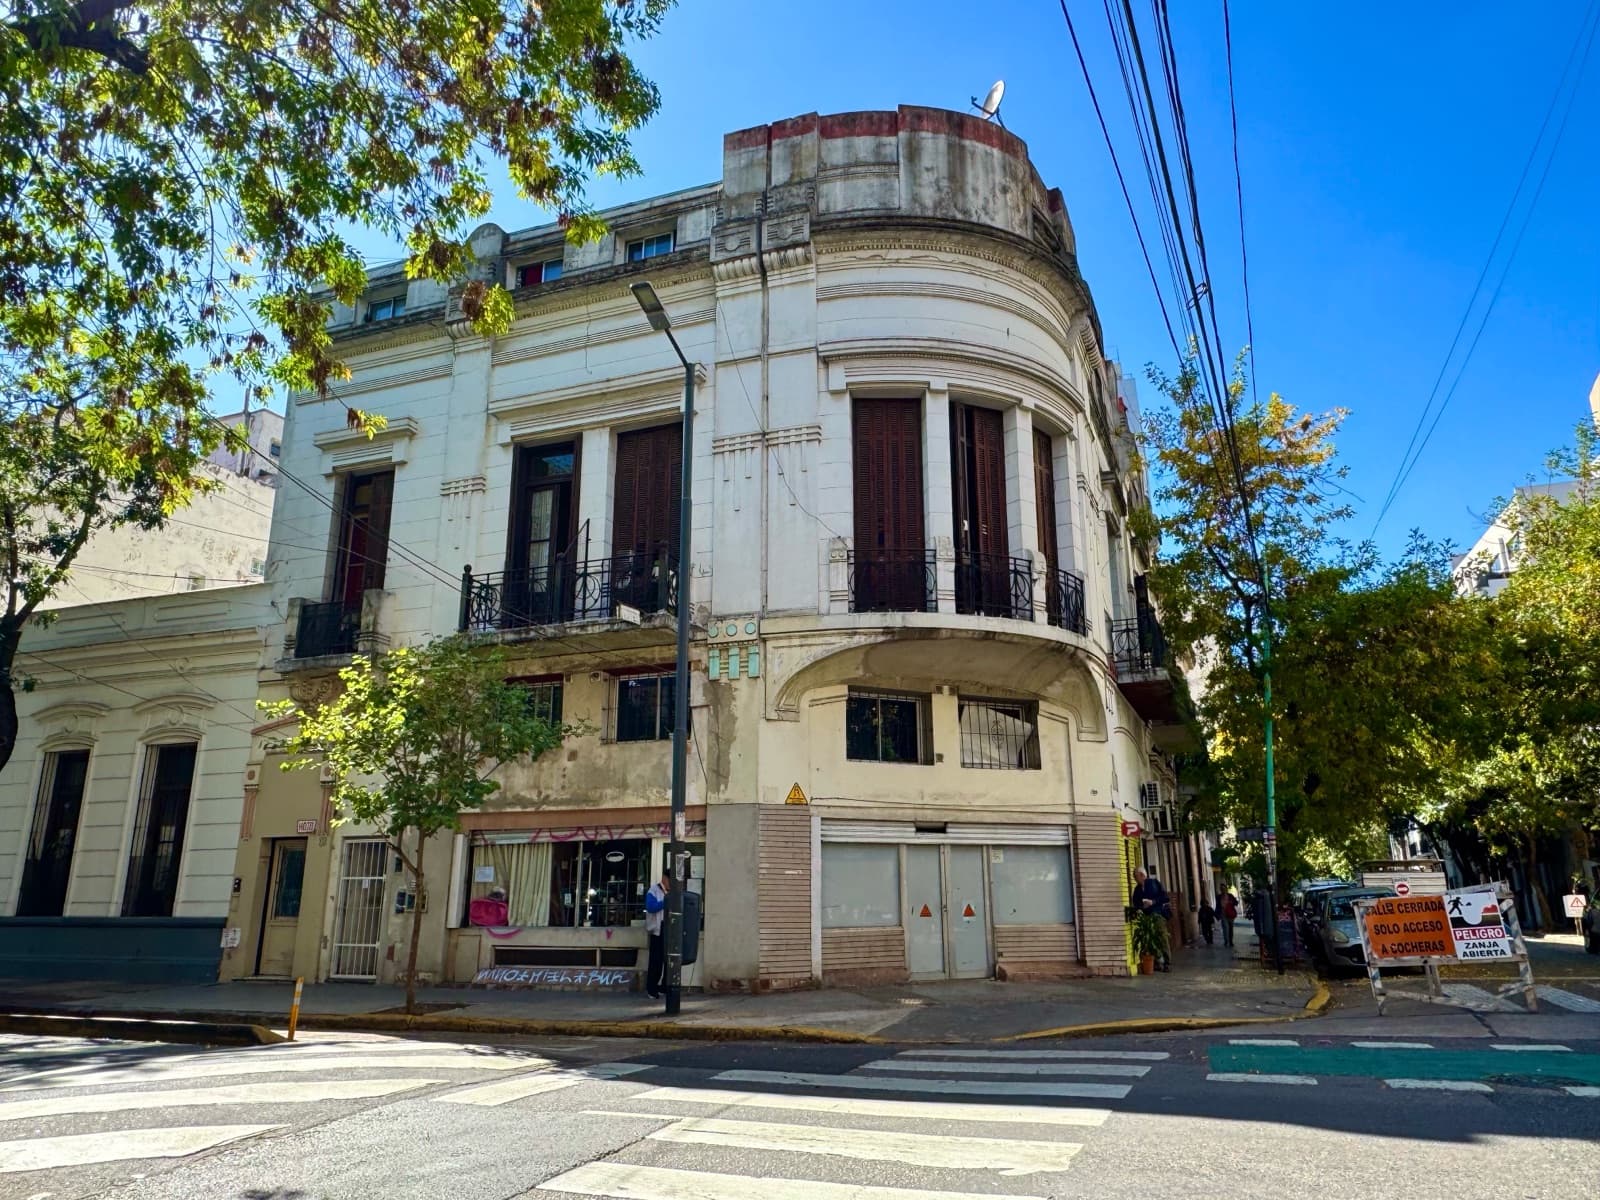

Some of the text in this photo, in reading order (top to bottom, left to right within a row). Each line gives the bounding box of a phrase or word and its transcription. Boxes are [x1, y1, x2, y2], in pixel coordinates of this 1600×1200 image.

[1397, 900, 1446, 914] CERRADA
[1374, 920, 1443, 936] SOLO ACCESO
[1455, 928, 1503, 940] PELIGRO
[1381, 940, 1446, 955] A COCHERAS
[1464, 941, 1500, 950] ZANJA
[1462, 949, 1507, 959] ABIERTA
